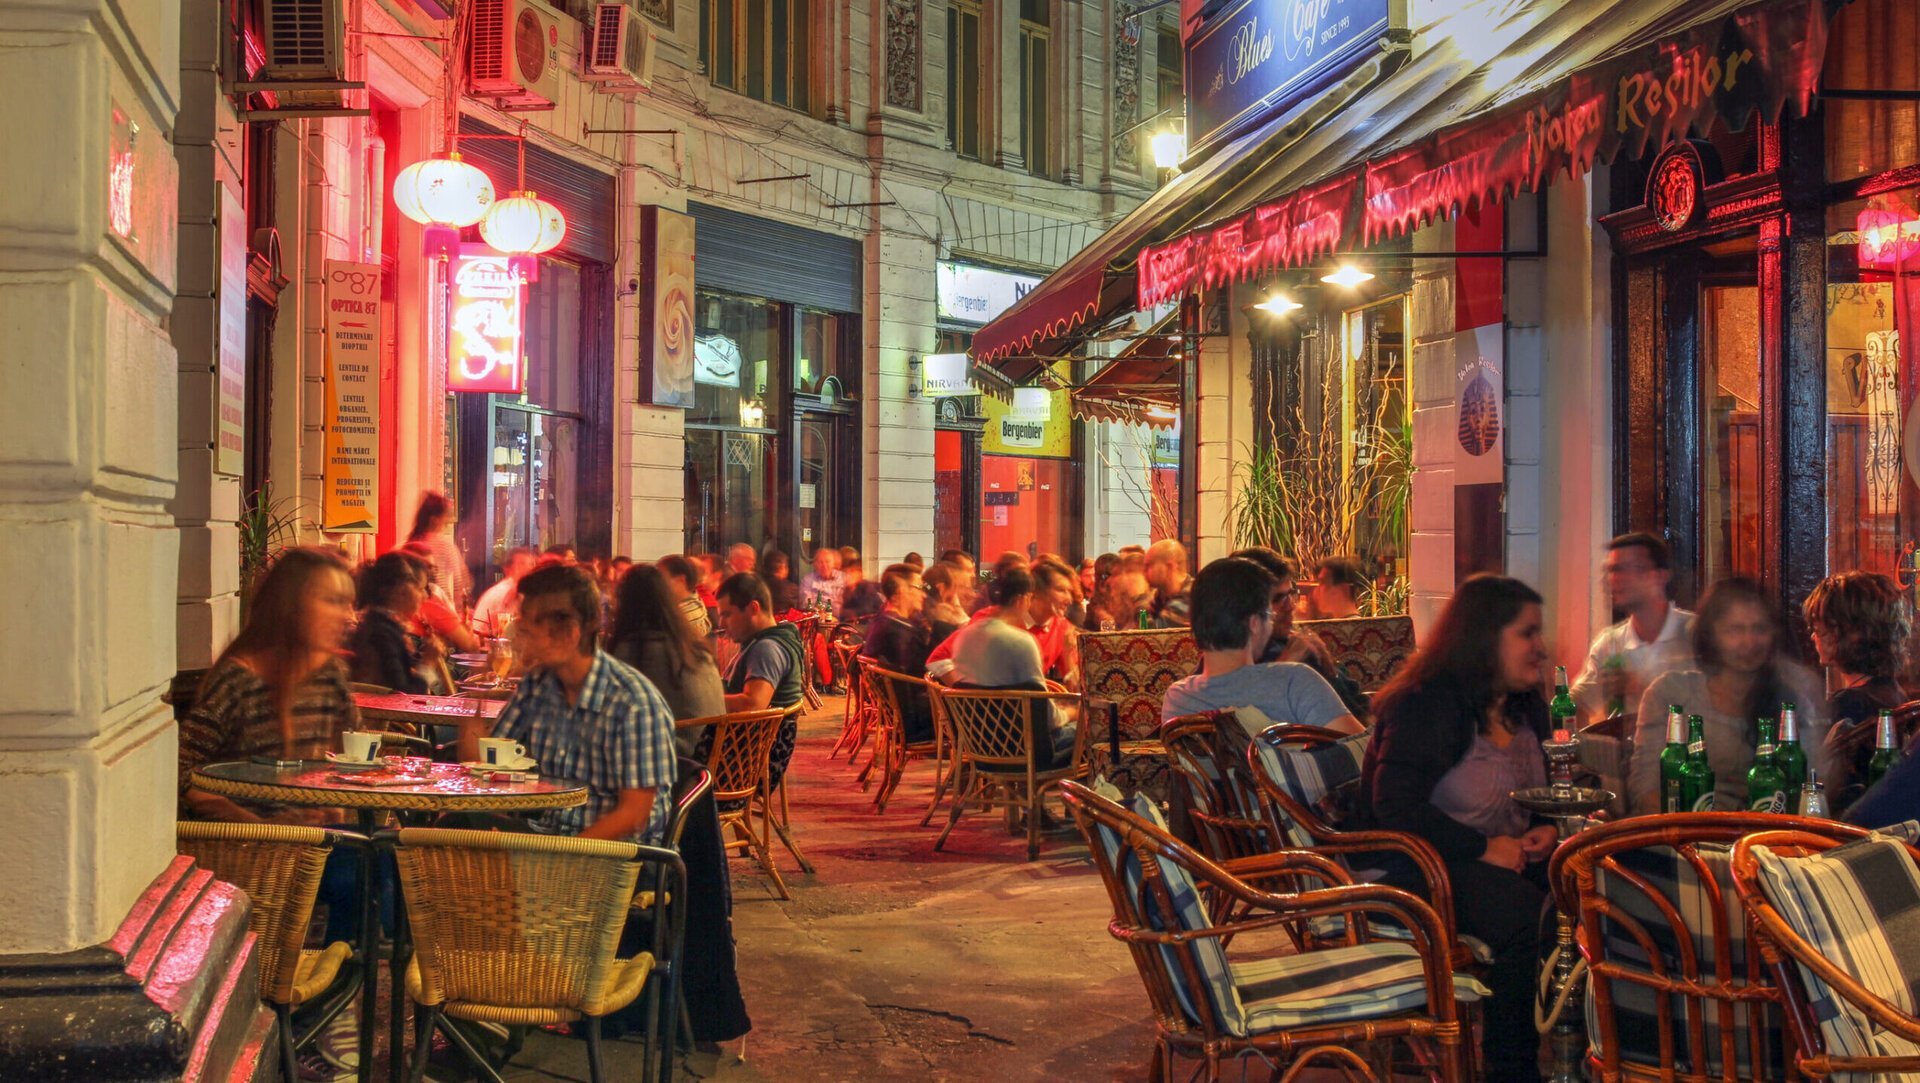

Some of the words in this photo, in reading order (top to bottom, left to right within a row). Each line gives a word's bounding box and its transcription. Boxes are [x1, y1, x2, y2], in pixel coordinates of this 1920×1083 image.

[1320, 23, 1338, 46] SINCE
[1338, 15, 1350, 33] 1993
[1227, 16, 1275, 85] Blues
[331, 299, 363, 314] OPTICA
[365, 302, 377, 315] 87
[339, 364, 360, 372] LENTILE
[361, 365, 369, 373] DE
[342, 374, 366, 382] CONTACT
[343, 395, 365, 403] LENTILE
[331, 425, 376, 434] FOTOCROMATICE
[1002, 420, 1043, 441] Bergenbier
[337, 447, 352, 455] RAME
[336, 478, 364, 486] REDUCERI
[341, 499, 366, 507] MAGAZIN
